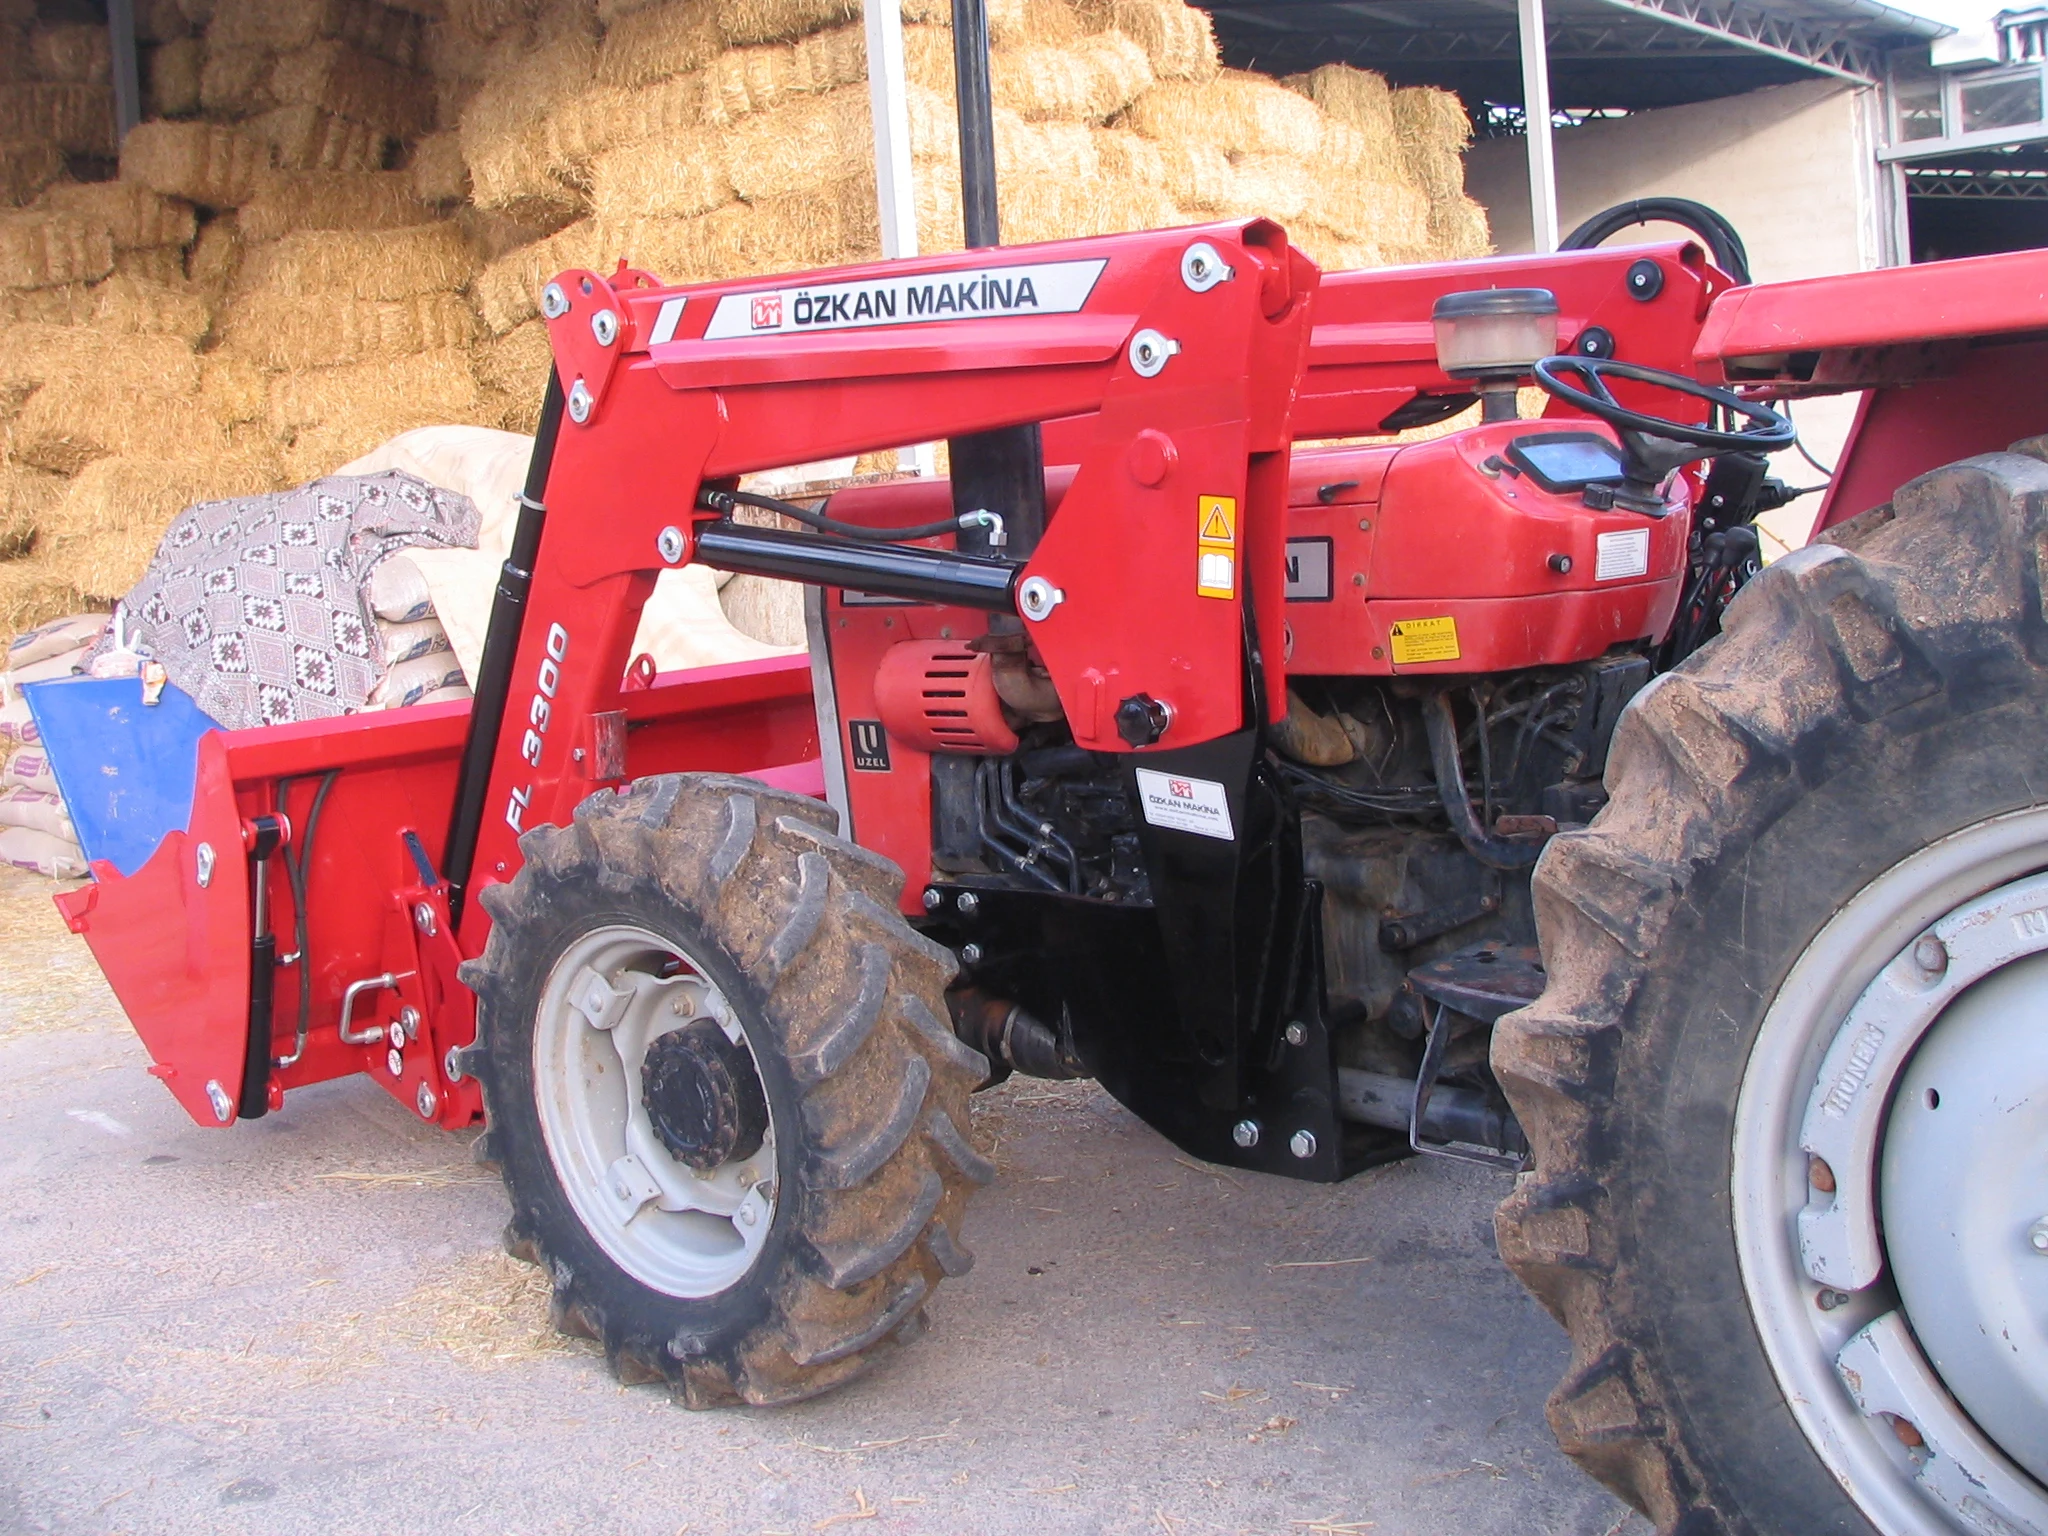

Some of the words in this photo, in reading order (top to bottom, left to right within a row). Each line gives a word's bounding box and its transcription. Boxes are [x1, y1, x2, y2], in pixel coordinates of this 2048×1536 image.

[793, 291, 896, 325] ÖZKAN
[906, 273, 1038, 315] MAKİNA
[521, 621, 569, 768] 3300
[856, 757, 887, 768] UZEL
[505, 784, 533, 835] FL
